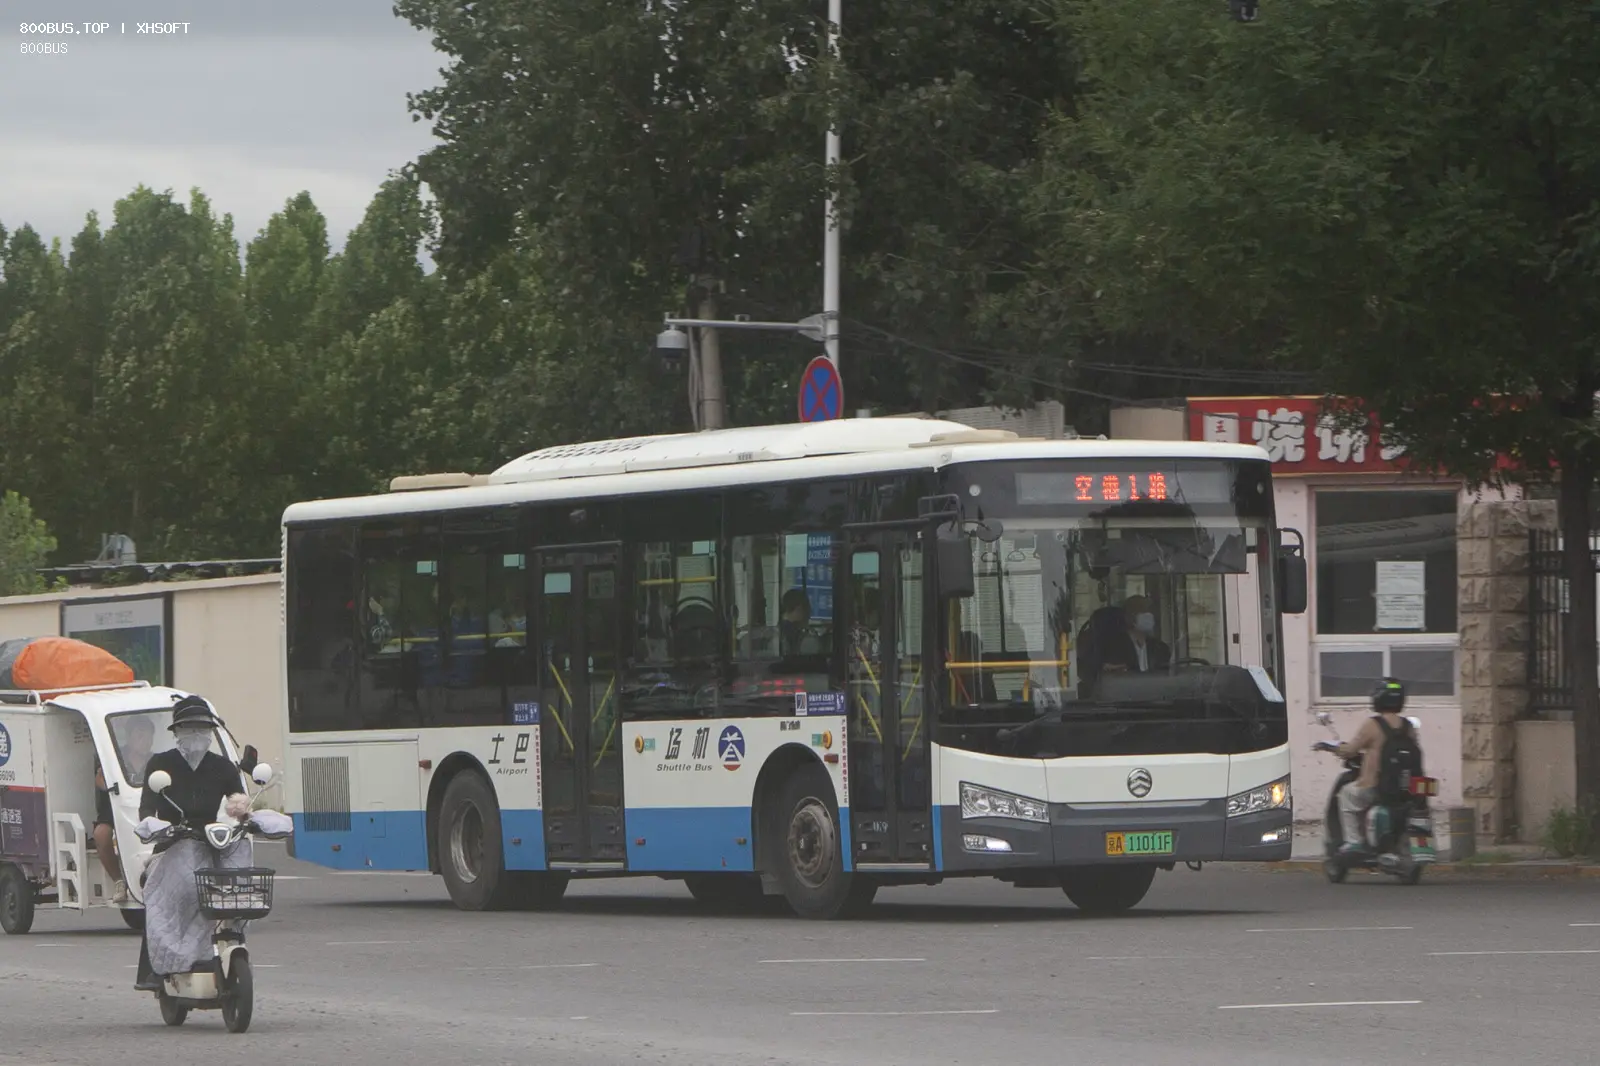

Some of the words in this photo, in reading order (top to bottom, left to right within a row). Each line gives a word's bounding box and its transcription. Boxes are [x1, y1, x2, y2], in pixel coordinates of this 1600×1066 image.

[496, 767, 529, 777] Airport
[656, 763, 692, 772] Shuttle
[695, 763, 713, 772] Bus
